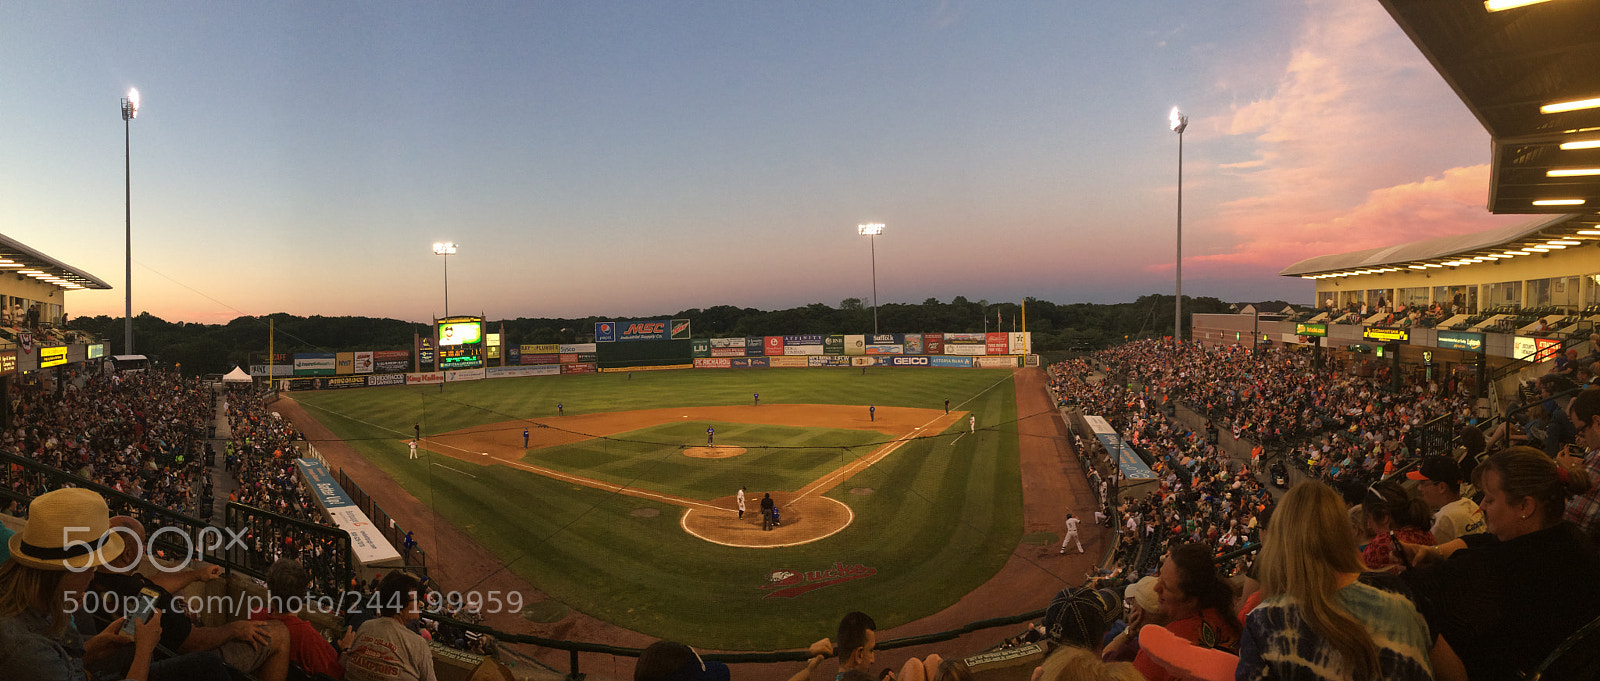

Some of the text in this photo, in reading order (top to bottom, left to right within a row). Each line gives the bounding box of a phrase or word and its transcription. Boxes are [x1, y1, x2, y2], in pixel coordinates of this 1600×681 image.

[623, 323, 664, 335] MSC
[693, 344, 707, 352] LIU
[272, 353, 286, 361] CAFE
[893, 357, 928, 365] GEICO
[758, 561, 877, 590] Ducks
